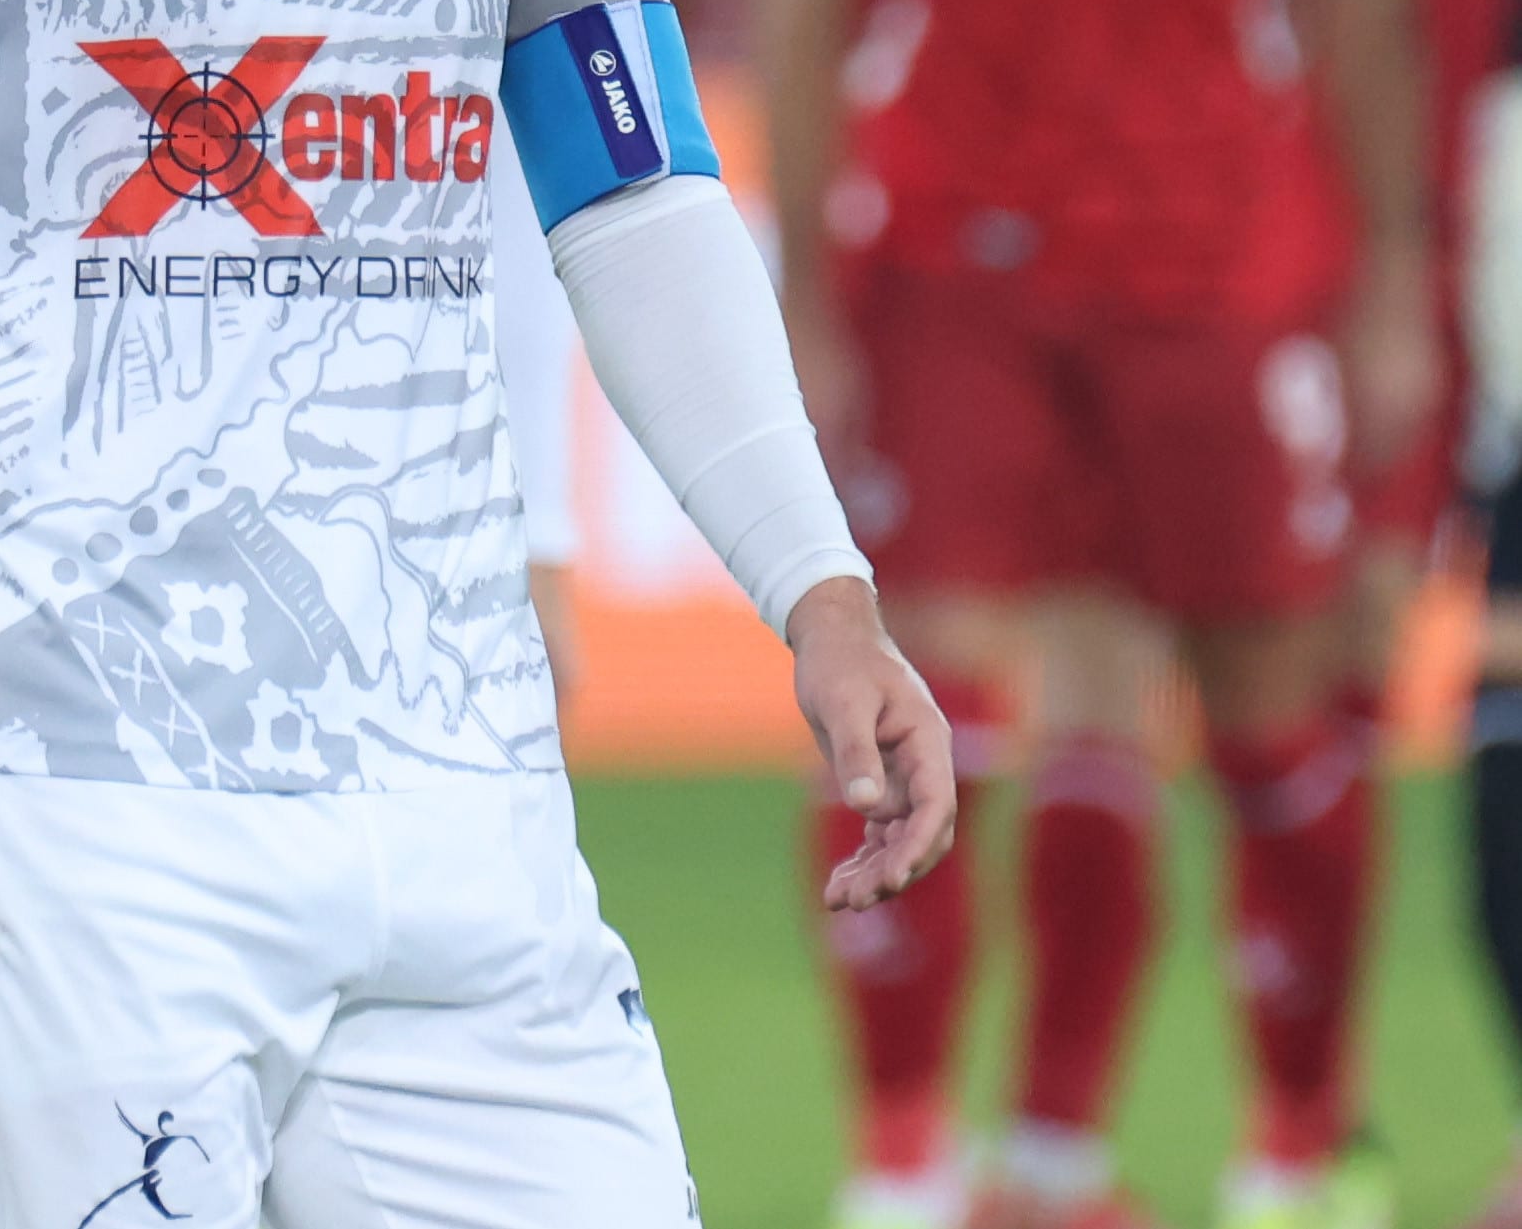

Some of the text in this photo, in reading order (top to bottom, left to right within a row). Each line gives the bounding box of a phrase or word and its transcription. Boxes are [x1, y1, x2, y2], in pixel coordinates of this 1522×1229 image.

[601, 80, 637, 134] JAKO
[75, 35, 494, 239] Xentra
[74, 255, 341, 299] ENERGY
